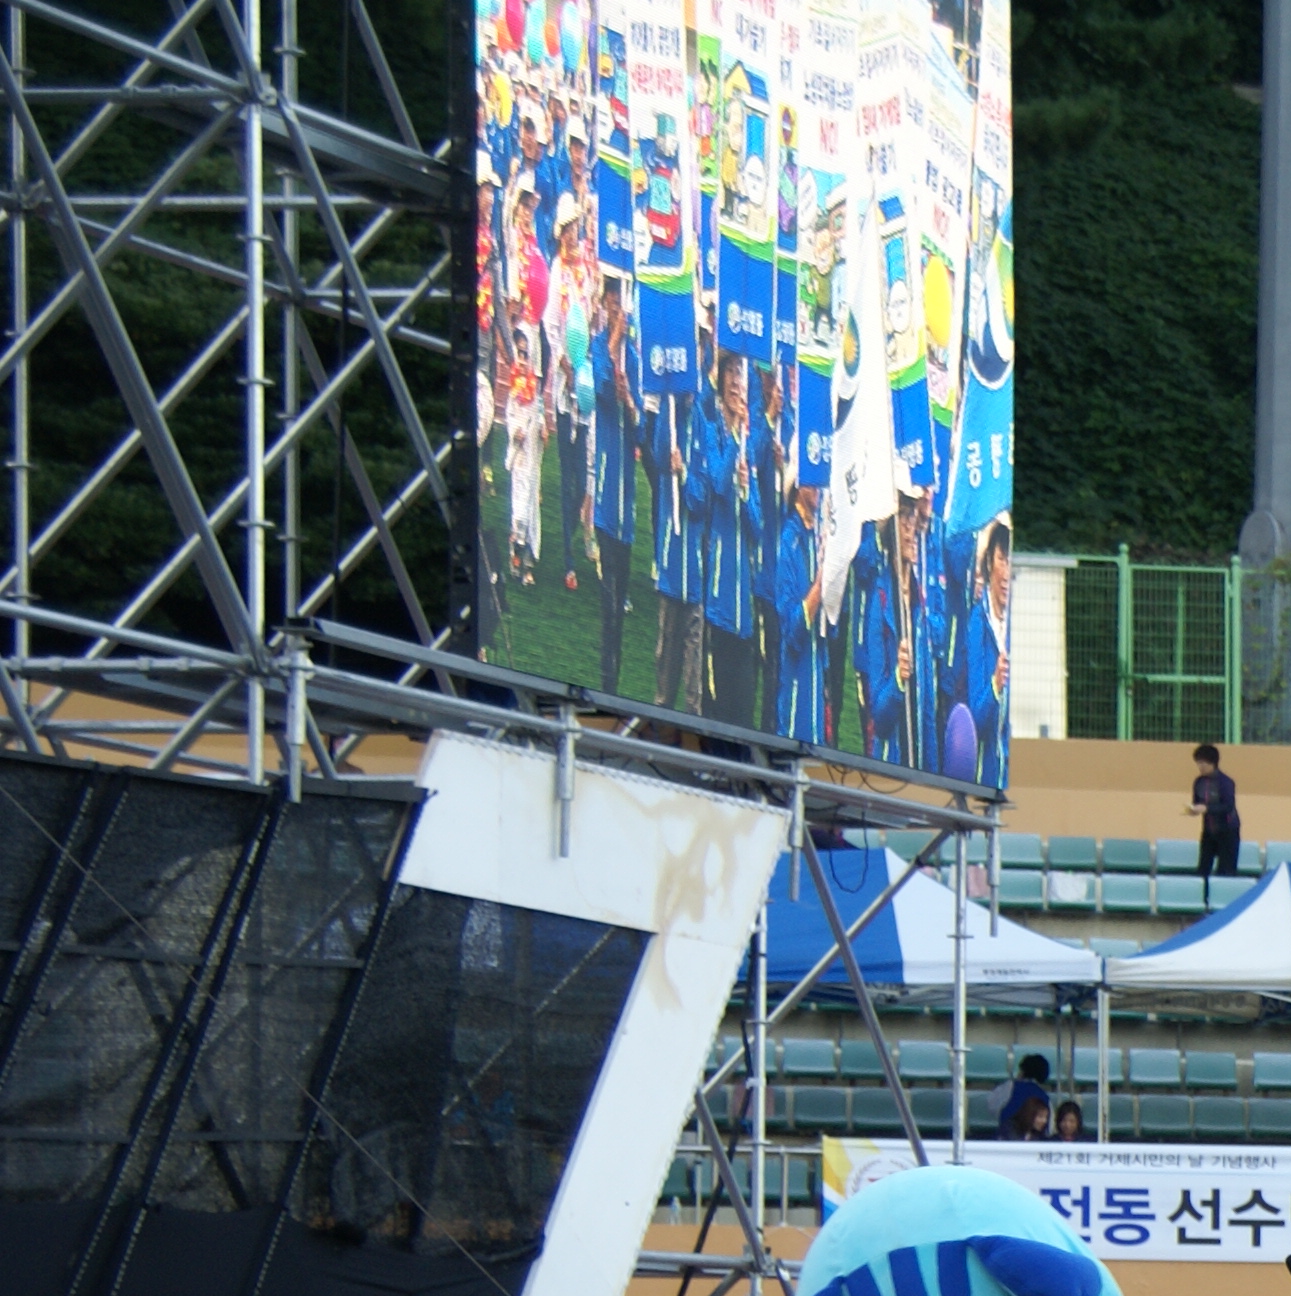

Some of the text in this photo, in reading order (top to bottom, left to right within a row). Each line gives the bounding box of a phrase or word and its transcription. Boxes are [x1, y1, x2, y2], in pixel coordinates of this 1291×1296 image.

[1037, 1150, 1277, 1170] 제21회 거제시민의 날 기념행사
